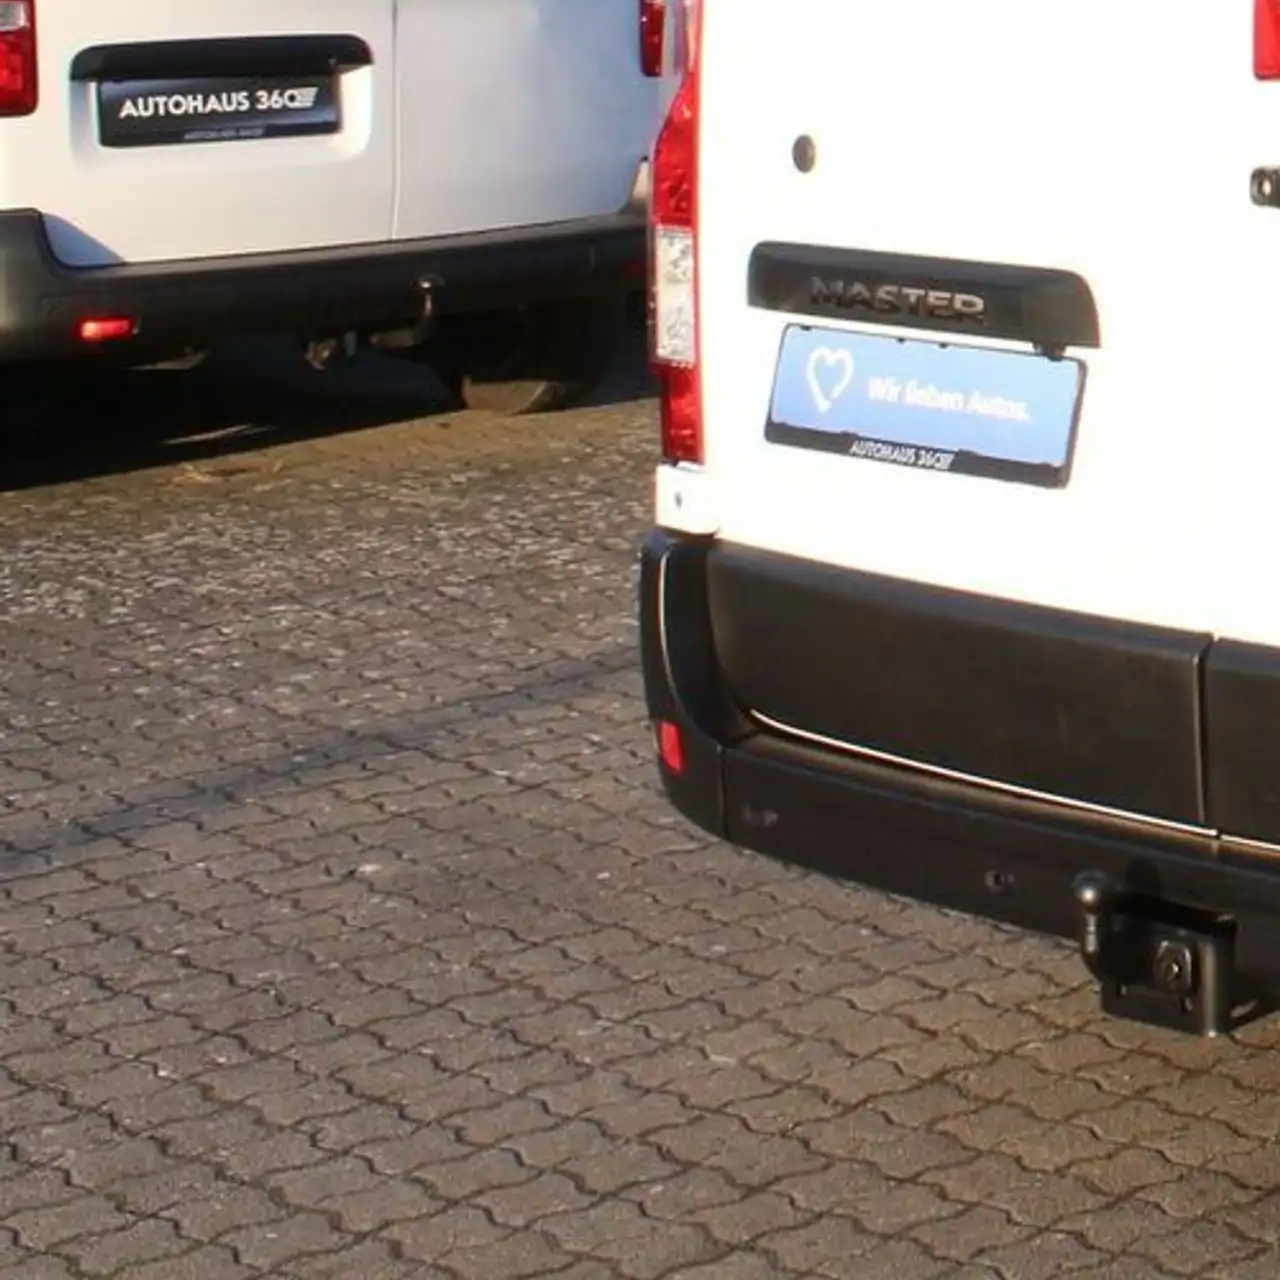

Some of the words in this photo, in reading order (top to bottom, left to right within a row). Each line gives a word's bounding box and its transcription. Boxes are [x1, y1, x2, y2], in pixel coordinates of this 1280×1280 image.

[118, 91, 250, 119] AUTOHAUS
[810, 275, 988, 324] MASTER
[867, 375, 902, 403] Wir
[849, 440, 916, 464] AUTOHAUS
